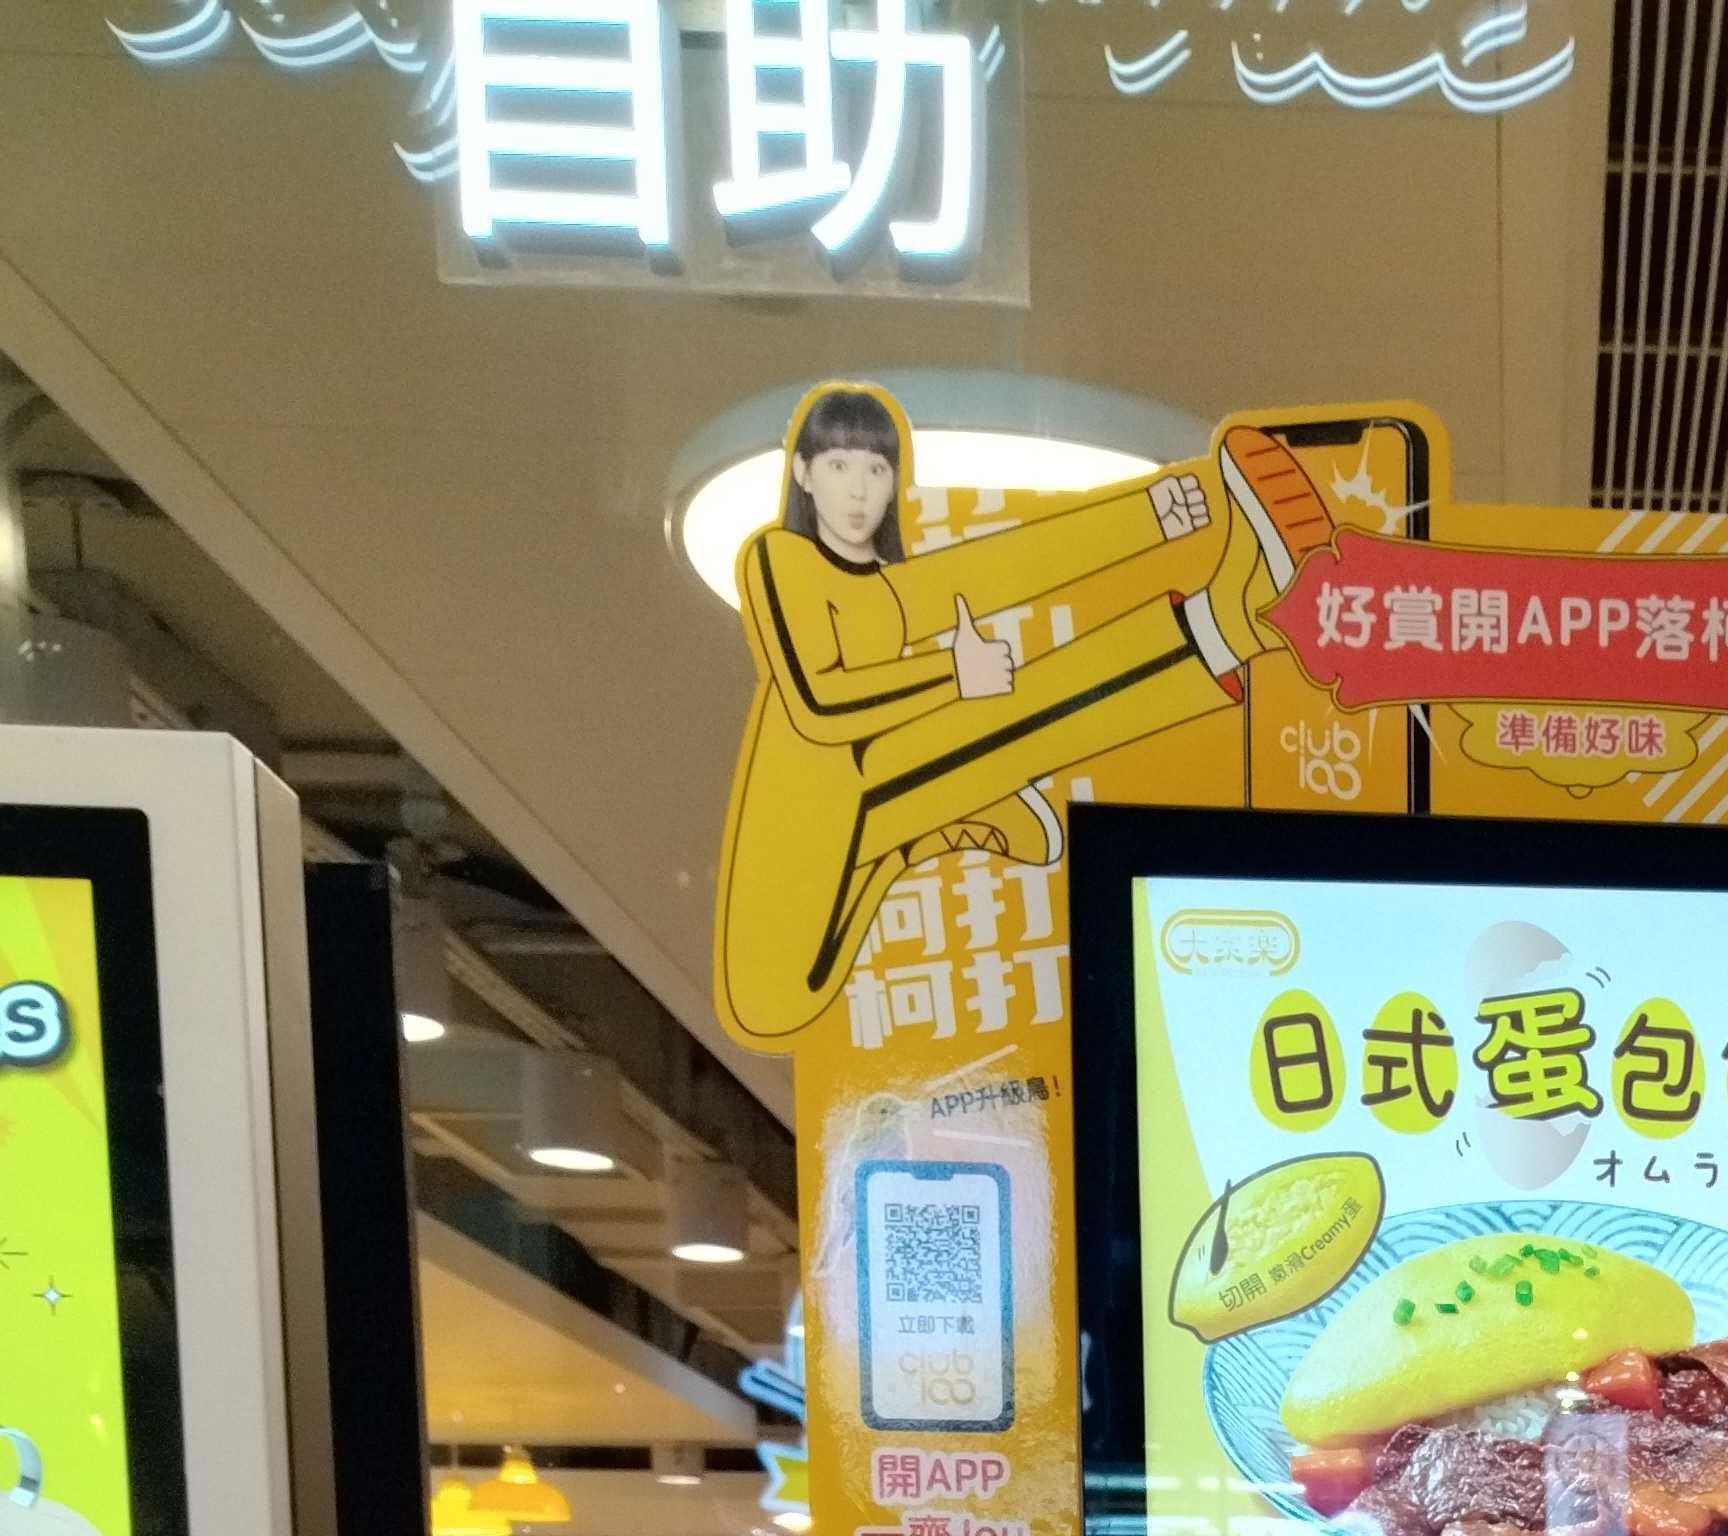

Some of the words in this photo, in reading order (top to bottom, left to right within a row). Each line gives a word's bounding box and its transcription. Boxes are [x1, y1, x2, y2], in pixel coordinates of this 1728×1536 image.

[452, 0, 975, 258] 自助
[1280, 719, 1361, 762] club
[1498, 712, 1665, 757] 準備好味
[845, 943, 1070, 1049] 柯打
[1218, 1271, 1268, 1313] 切開
[876, 1454, 1006, 1499] 開APP
